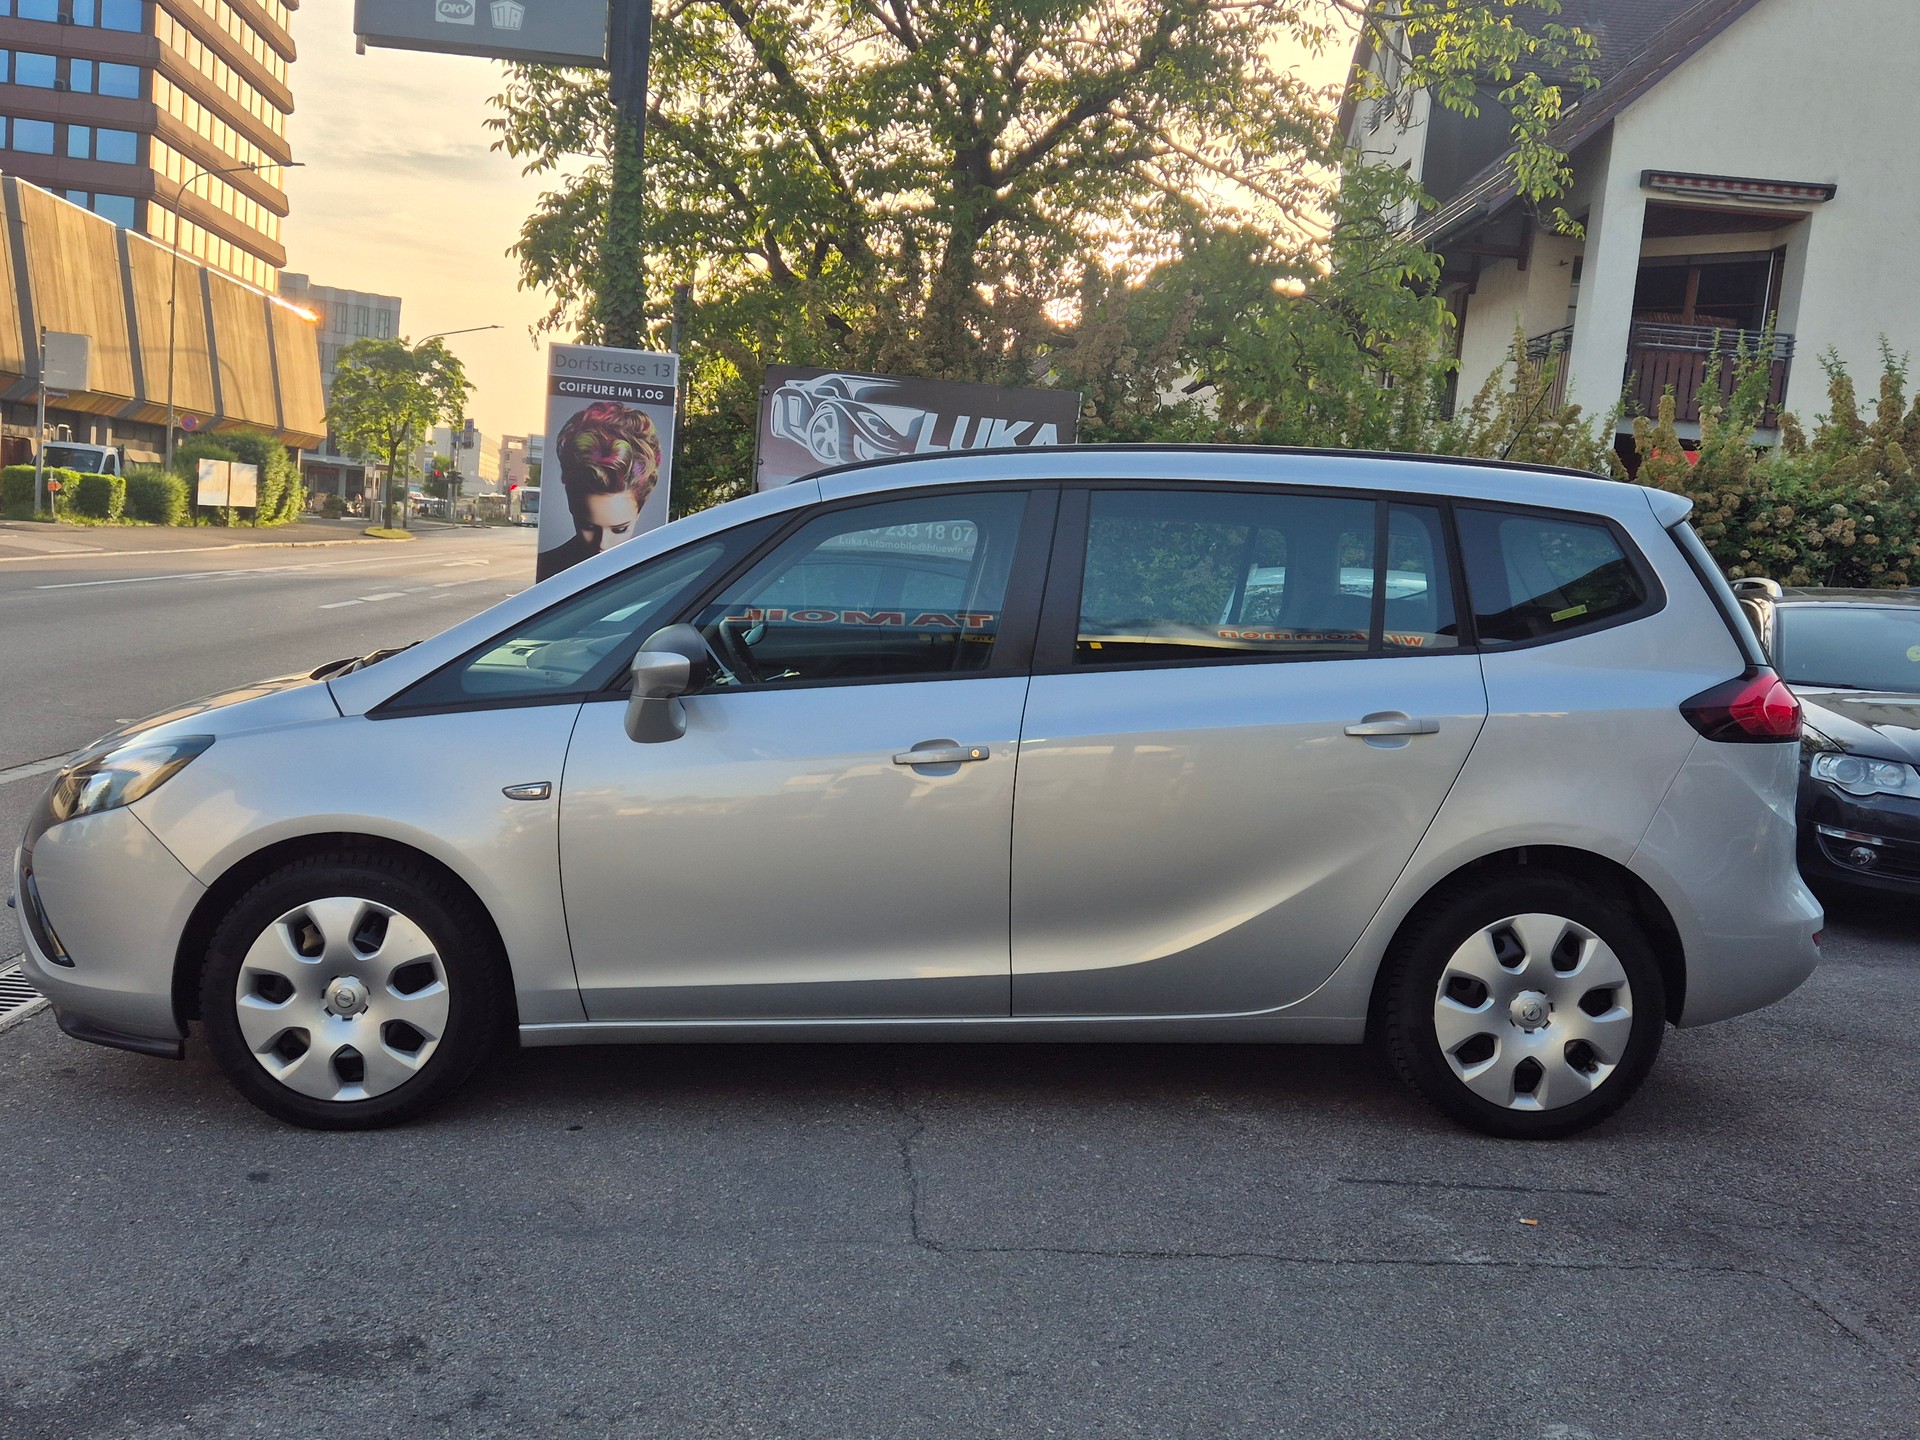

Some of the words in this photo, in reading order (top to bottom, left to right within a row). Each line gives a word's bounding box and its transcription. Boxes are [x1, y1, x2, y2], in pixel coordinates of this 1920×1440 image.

[441, 2, 471, 14] DKV
[491, 0, 524, 29] UTA
[555, 354, 646, 375] Dorfstrasse
[653, 363, 670, 378] 13
[559, 381, 615, 396] COIFFURE
[618, 387, 632, 398] IM
[636, 388, 664, 400] 1.OG
[914, 412, 1058, 454] LUKA
[925, 524, 946, 540] 18
[951, 526, 974, 542] 07
